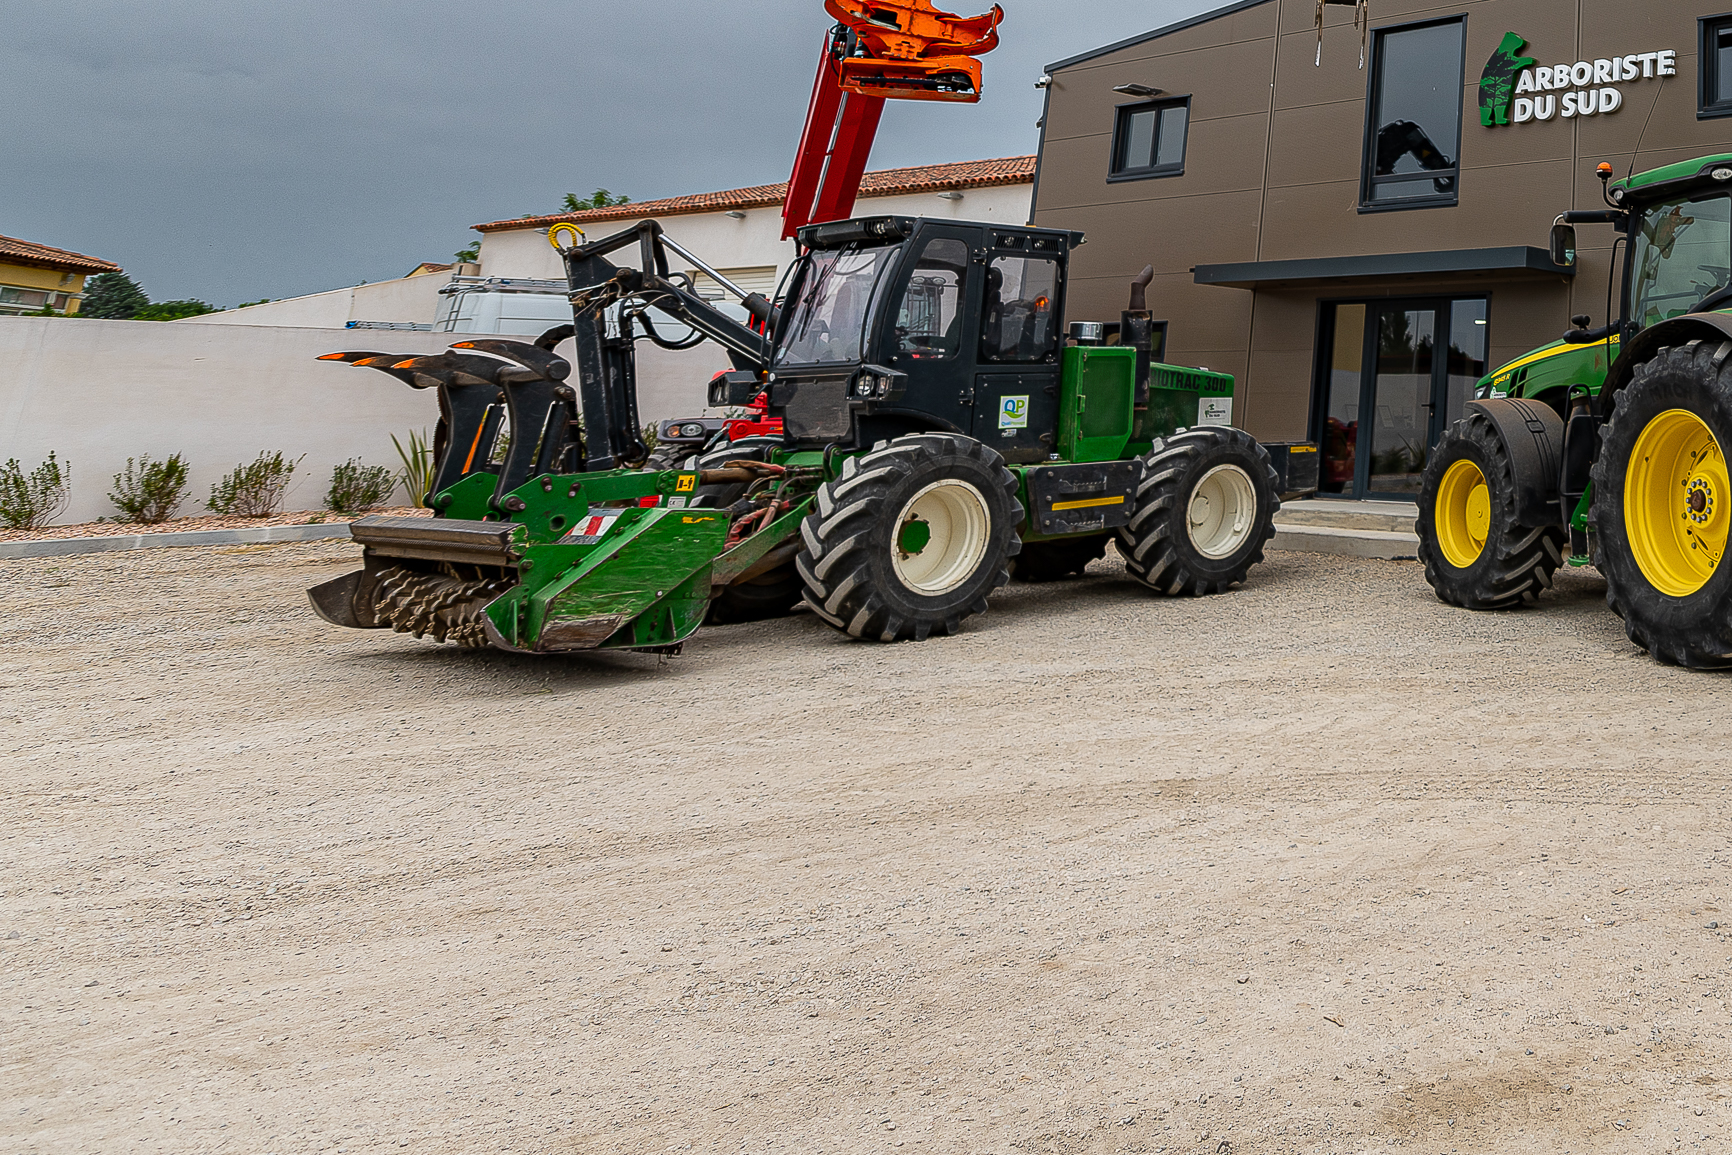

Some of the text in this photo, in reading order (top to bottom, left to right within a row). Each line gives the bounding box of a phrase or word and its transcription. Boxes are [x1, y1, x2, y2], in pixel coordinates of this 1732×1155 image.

[1515, 49, 1676, 94] ARBORISTE
[1513, 87, 1622, 123] DU SUD
[1204, 376, 1226, 392] 300
[1004, 399, 1025, 413] QP
